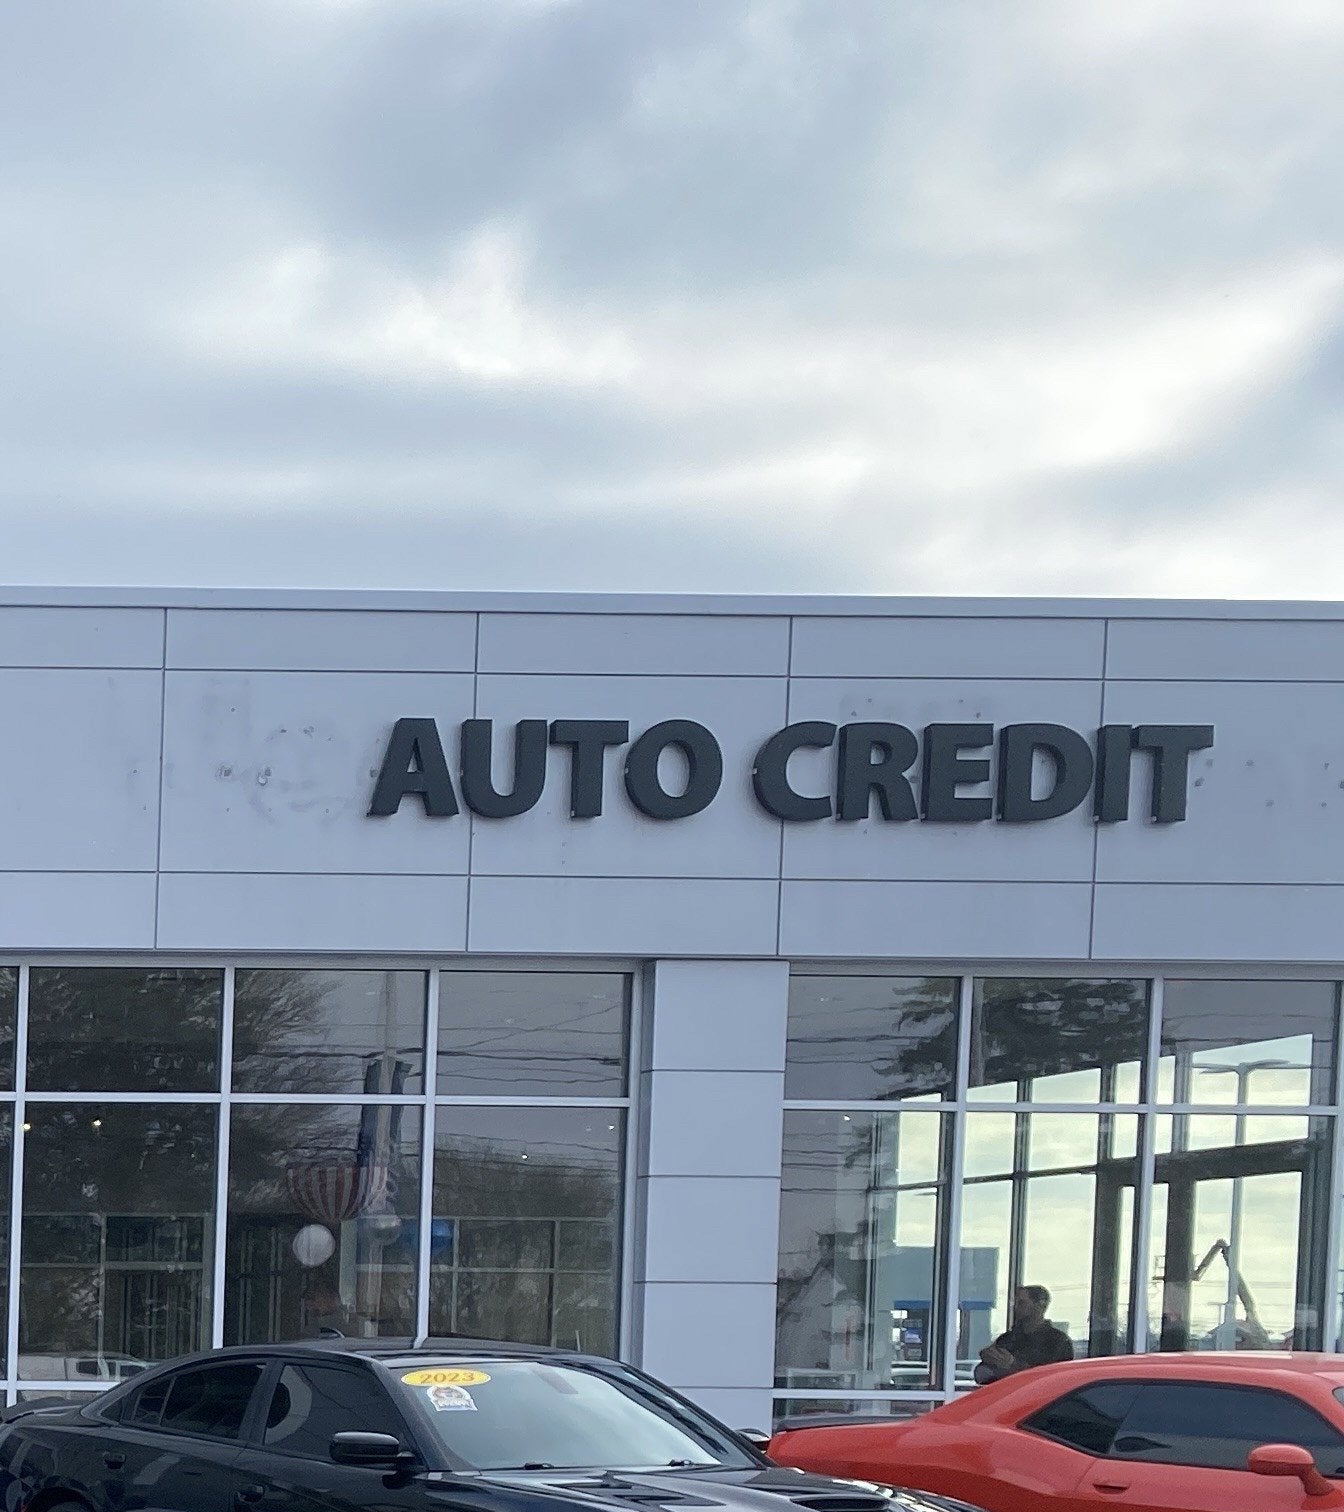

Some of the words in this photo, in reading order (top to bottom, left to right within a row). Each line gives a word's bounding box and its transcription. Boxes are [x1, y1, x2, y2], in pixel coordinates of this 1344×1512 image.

[366, 717, 724, 821] AUTO
[752, 720, 1215, 824] CREDIT
[419, 1372, 475, 1384] 2023
